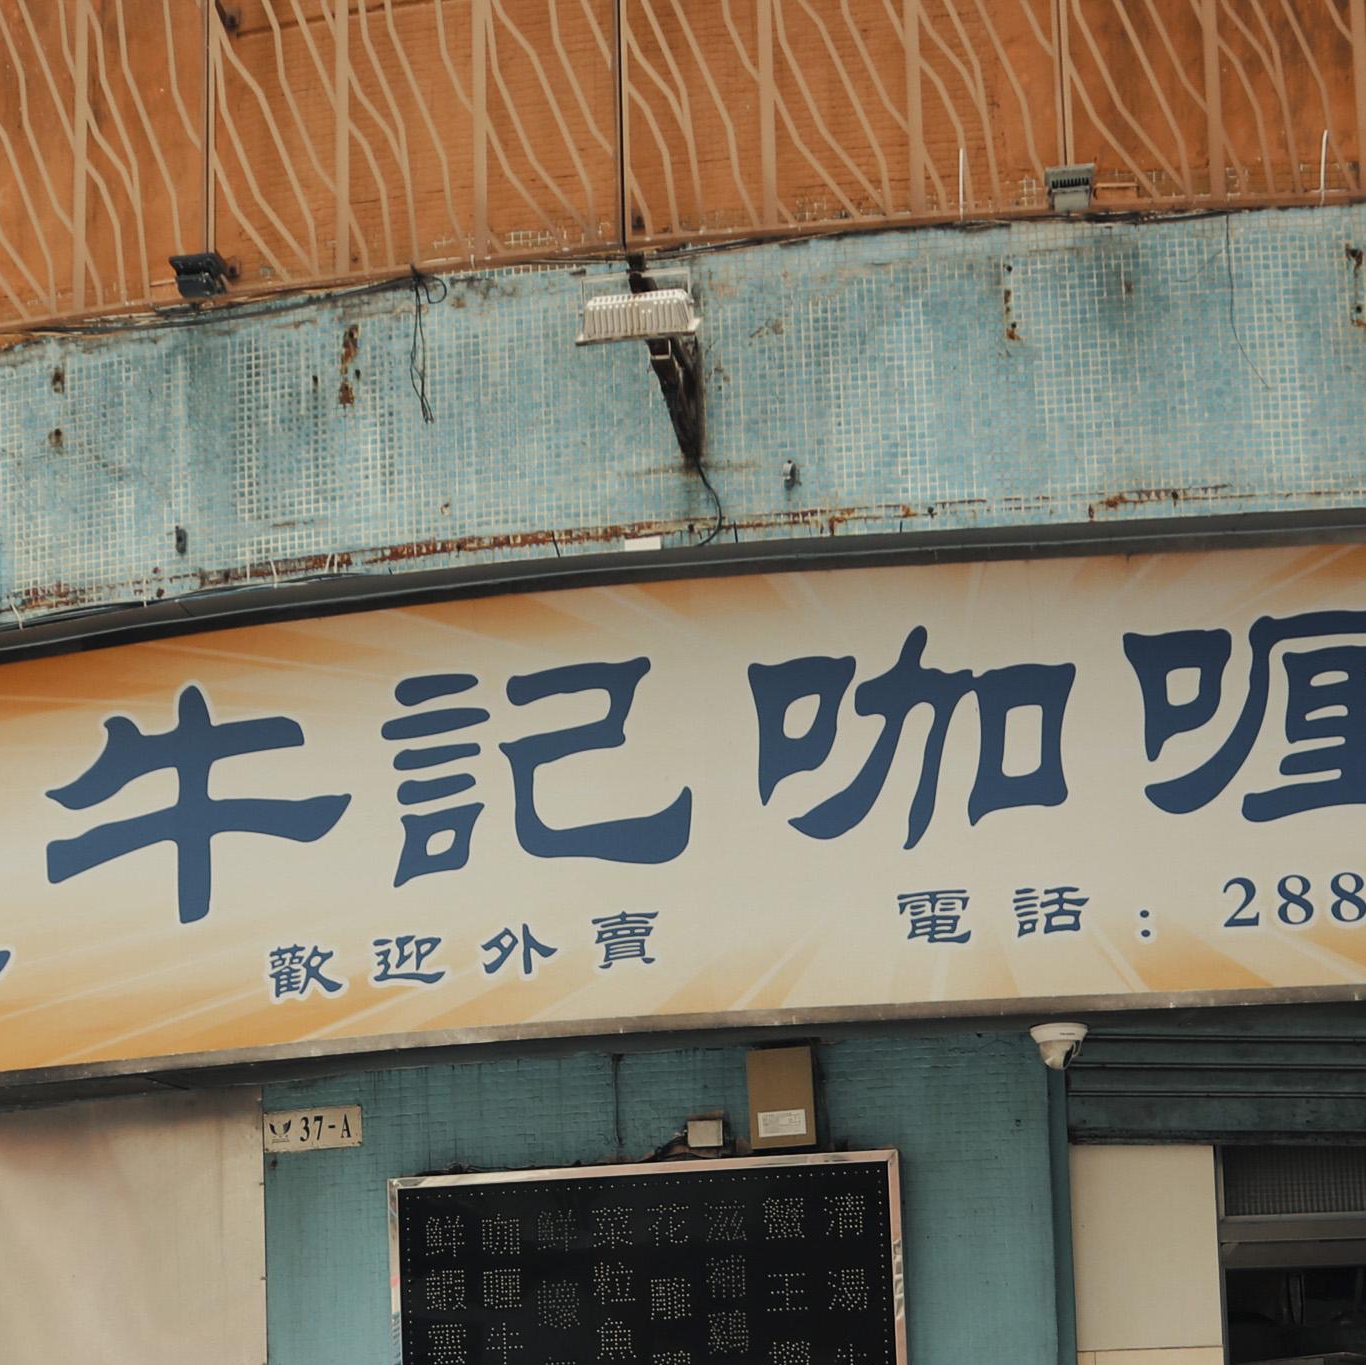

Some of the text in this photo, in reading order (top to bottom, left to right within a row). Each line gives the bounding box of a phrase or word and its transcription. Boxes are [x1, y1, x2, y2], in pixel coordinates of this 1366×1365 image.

[268, 910, 660, 999] 歡迎外賣
[299, 1113, 353, 1142] 37-A
